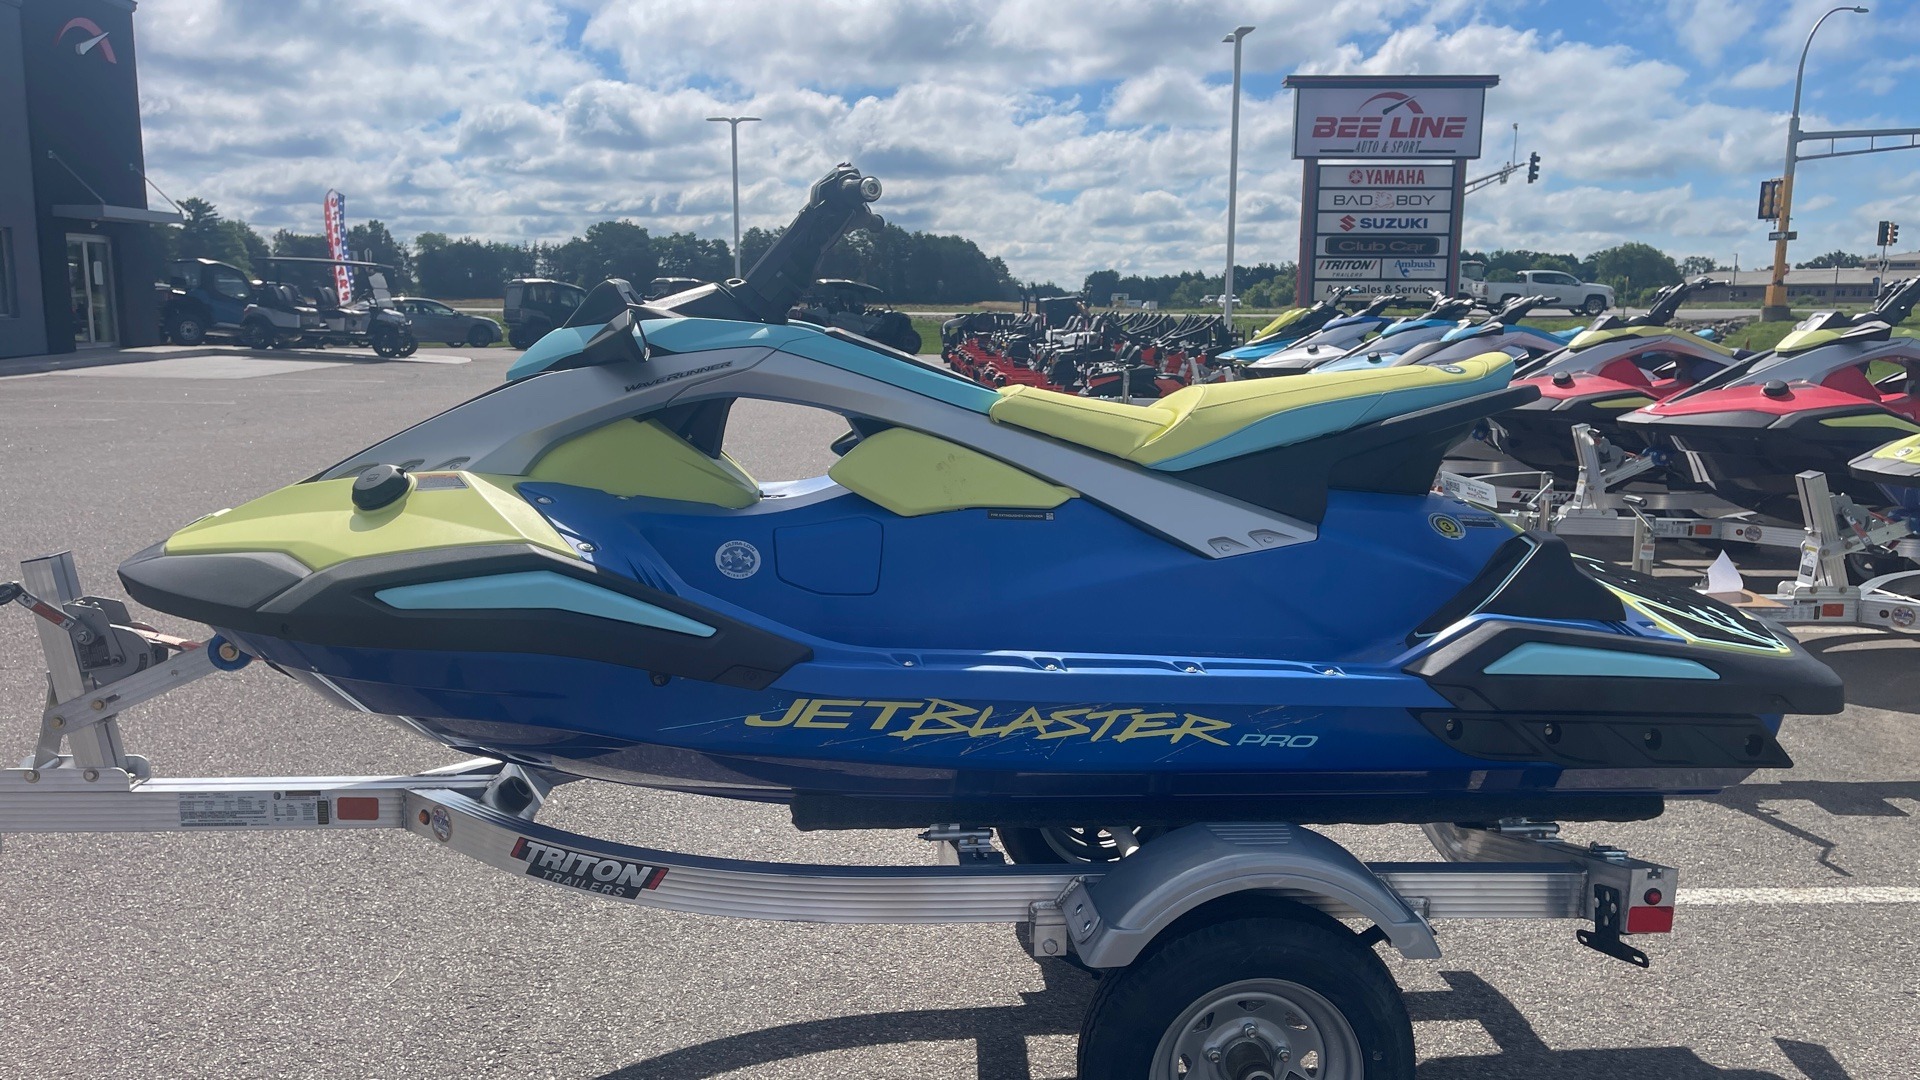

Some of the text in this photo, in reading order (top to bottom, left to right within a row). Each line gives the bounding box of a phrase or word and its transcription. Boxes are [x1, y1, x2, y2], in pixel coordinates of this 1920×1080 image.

[1312, 117, 1468, 138] BEE LINE
[1356, 141, 1422, 153] AUTO & SPORT
[1366, 170, 1425, 184] YAMAHA
[1334, 195, 1436, 206] BAD BOY
[1360, 218, 1428, 229] SUZUKI
[1338, 240, 1427, 252] Club Car
[1325, 260, 1372, 270] TRITON
[1394, 260, 1436, 268] Ambush
[1356, 284, 1382, 294] Sales
[1384, 285, 1393, 294] &
[1395, 284, 1434, 294] Service
[624, 360, 734, 392] WAVERUNNER
[1520, 491, 1572, 501] TRON
[744, 698, 1319, 748] JETBLASTER PRO
[525, 840, 653, 888] TRITON
[543, 869, 626, 897] TRAILERS
